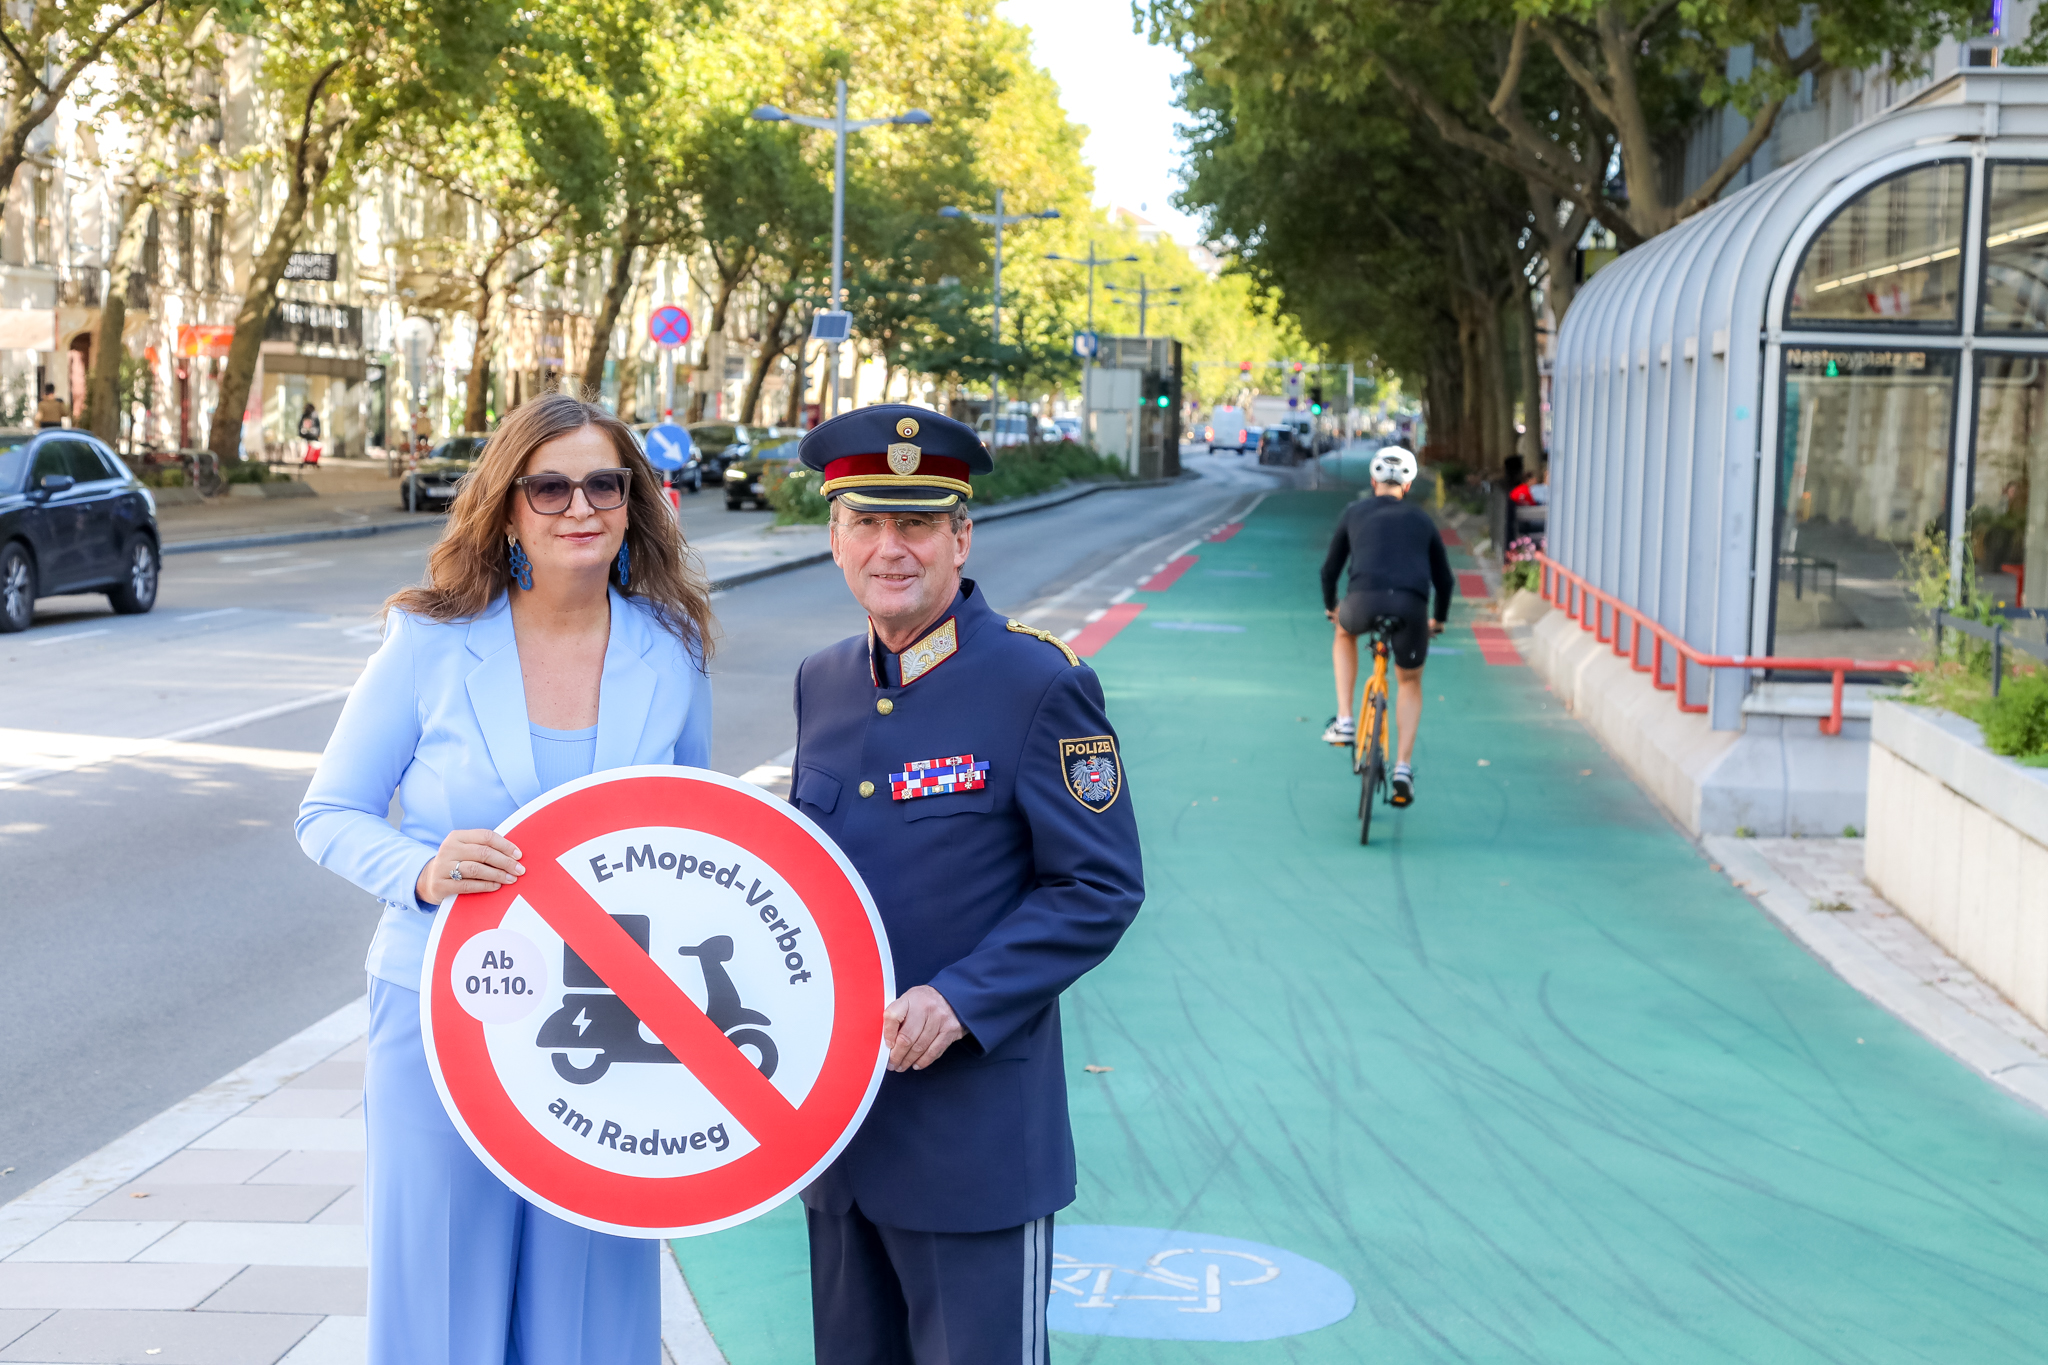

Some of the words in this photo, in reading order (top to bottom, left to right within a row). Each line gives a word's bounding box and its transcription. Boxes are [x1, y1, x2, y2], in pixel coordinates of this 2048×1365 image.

[589, 843, 812, 985] E-Moped-Verbot
[481, 950, 514, 969] Ab
[465, 975, 534, 995] 01.10.
[548, 1097, 593, 1138] am
[597, 1120, 731, 1156] Radweg
